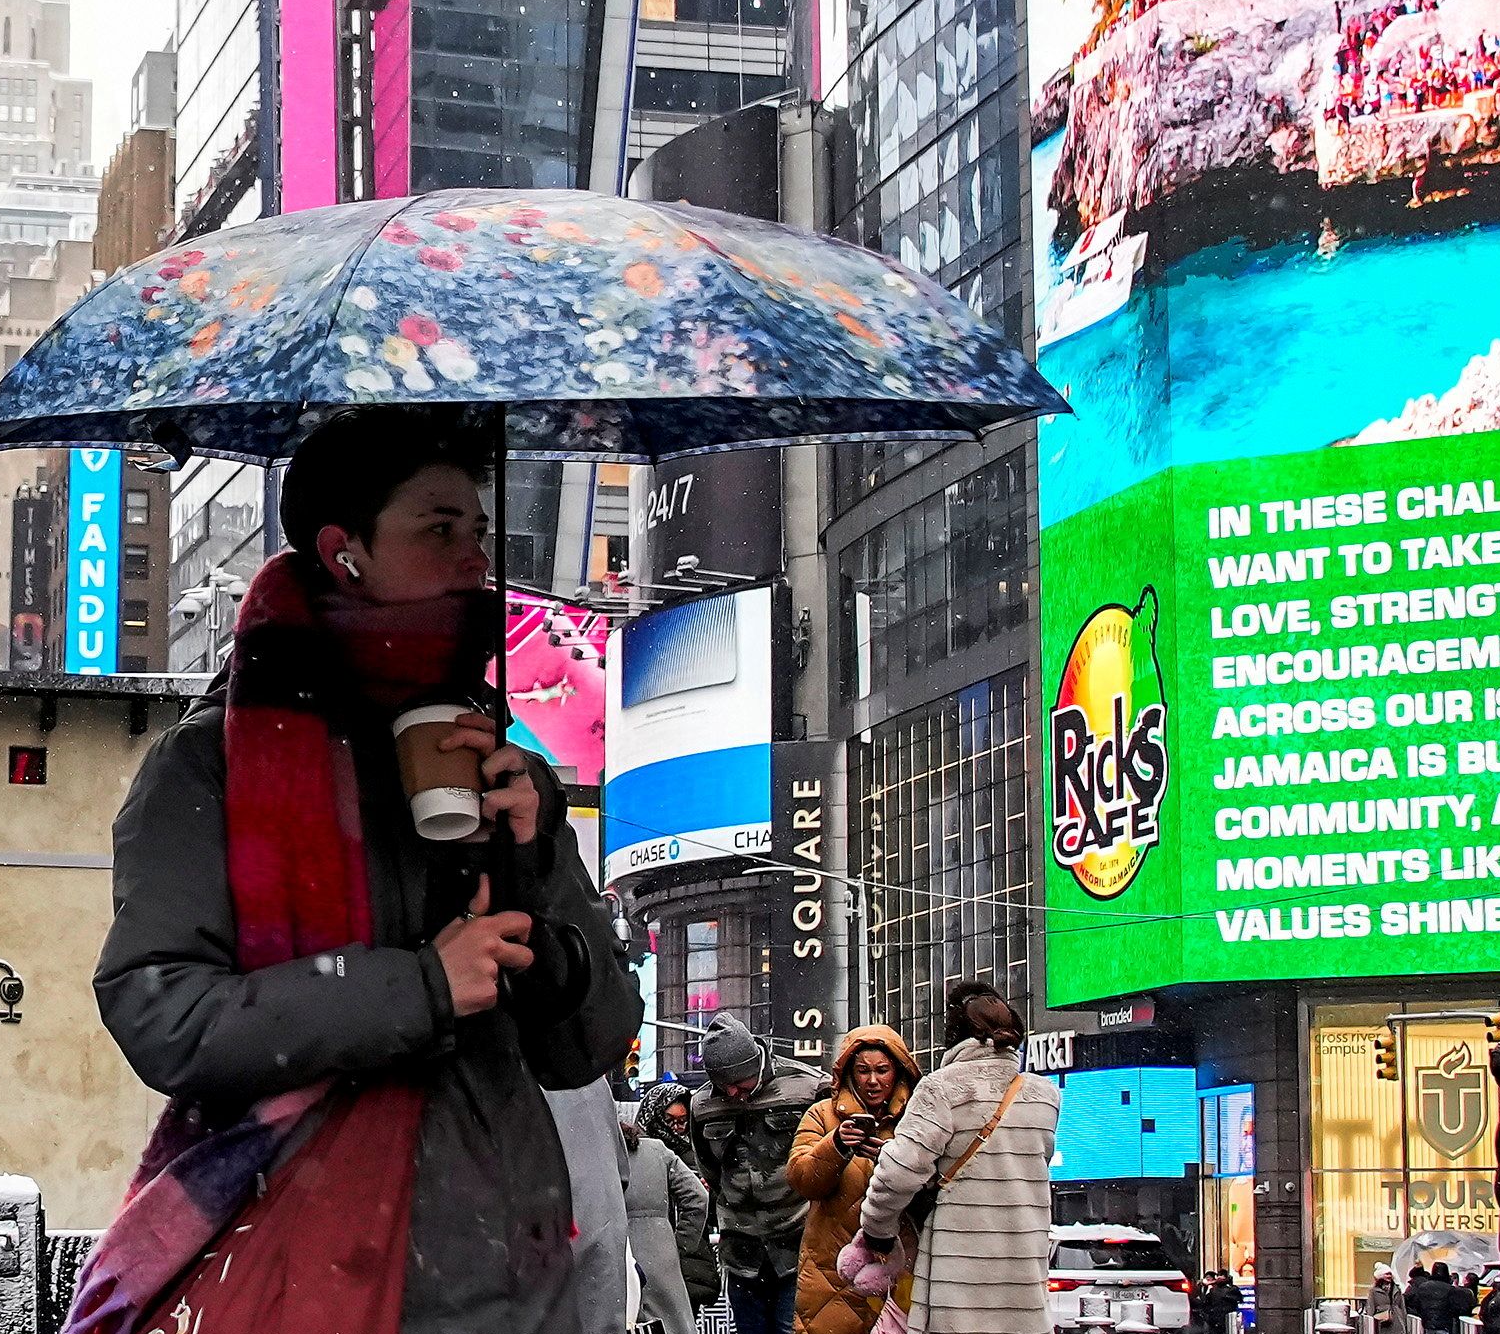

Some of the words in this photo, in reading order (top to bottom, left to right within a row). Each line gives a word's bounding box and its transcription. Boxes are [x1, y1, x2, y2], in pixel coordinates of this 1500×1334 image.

[647, 474, 693, 530] 24/7
[1208, 504, 1250, 539] IN
[1261, 491, 1387, 533] THESE
[1208, 546, 1330, 590] WANT
[1338, 541, 1392, 576] TO
[1210, 600, 1321, 639] LOVE,
[1212, 697, 1375, 740] ACROSS
[1386, 690, 1473, 727] OUR
[1213, 747, 1398, 791] JAMAICA
[1407, 743, 1447, 778] IS
[1056, 807, 1156, 857] CAFE
[1215, 793, 1482, 840] COMMUNITY,
[630, 843, 666, 867] CHASE
[792, 779, 823, 959] SQUARE
[1108, 850, 1141, 887] JAMAICA
[1216, 849, 1430, 892] MOMENTS
[1215, 906, 1371, 942] VALUES
[1101, 1006, 1133, 1028] branded
[1026, 1031, 1076, 1071] AT&T
[1315, 1032, 1350, 1045] cross
[1351, 1031, 1382, 1044] river
[1315, 1043, 1367, 1056] campus
[1381, 1180, 1496, 1210] TOUR
